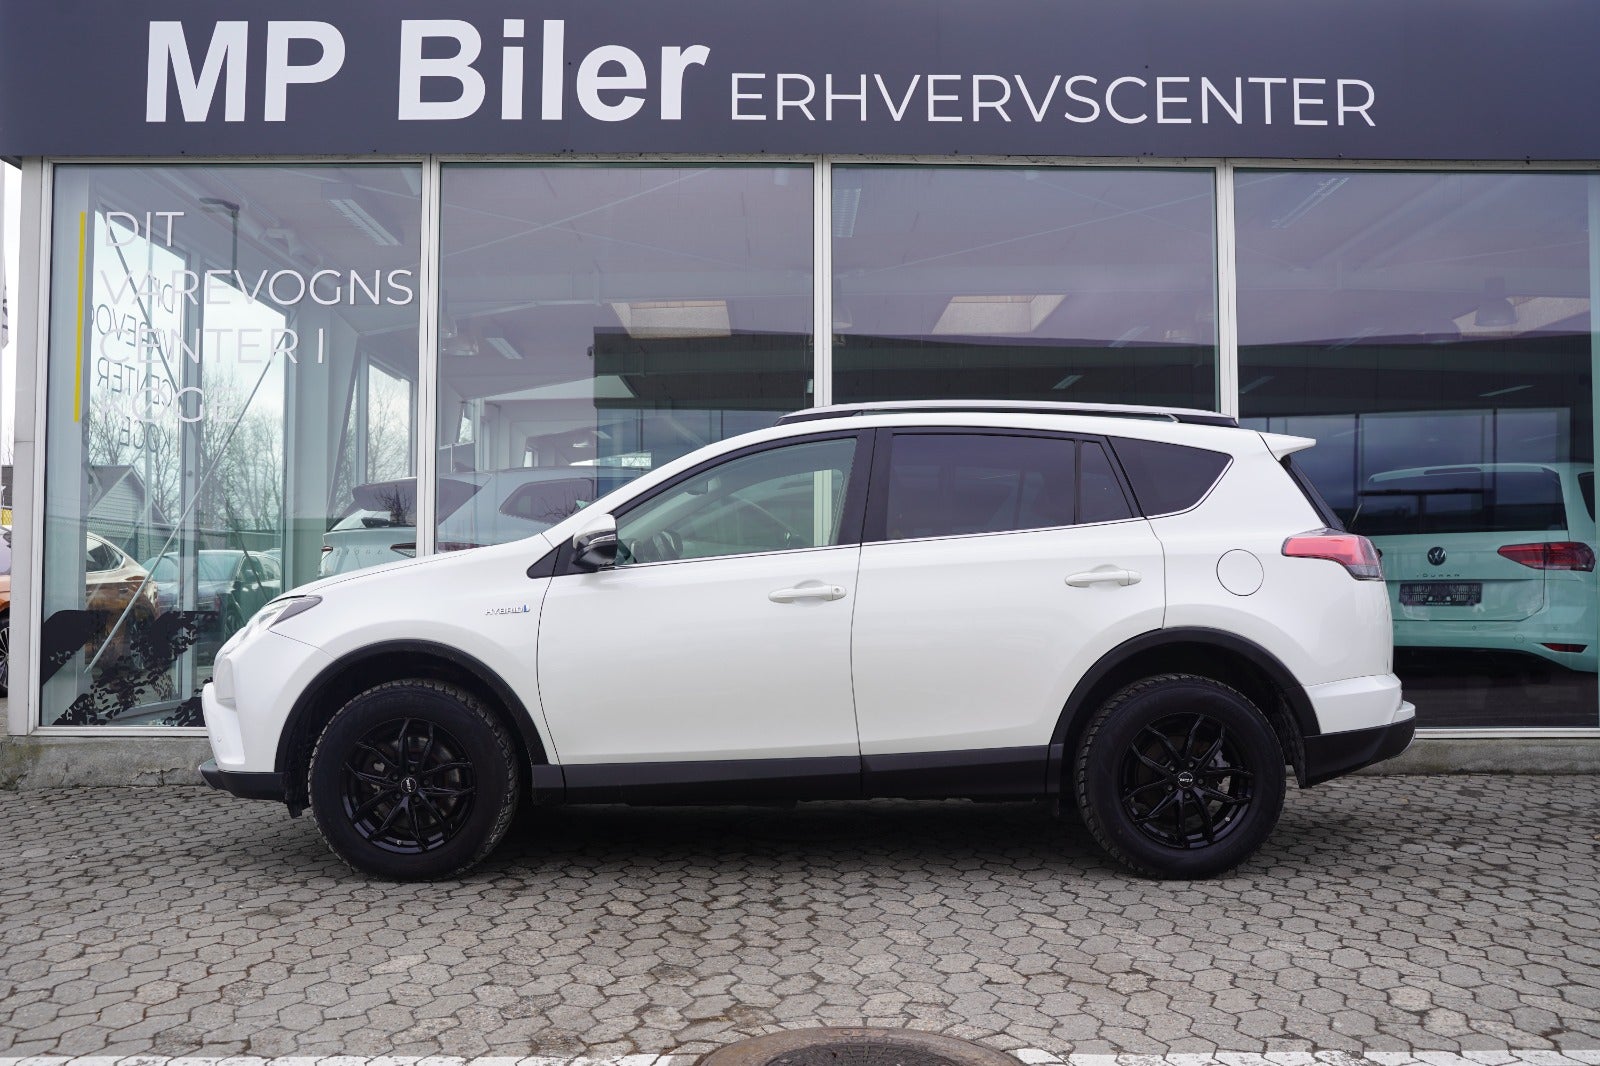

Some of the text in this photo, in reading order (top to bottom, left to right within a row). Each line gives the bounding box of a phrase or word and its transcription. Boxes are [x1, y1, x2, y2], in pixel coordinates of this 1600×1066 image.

[145, 19, 710, 122] MP Biler
[730, 72, 1376, 127] ERHVERVSCENTER
[105, 212, 185, 247] DIT
[99, 268, 414, 306] VAREVOGNS
[99, 327, 325, 364] CENTER I
[99, 386, 239, 422] KØGE
[485, 606, 524, 616] HYBRID
